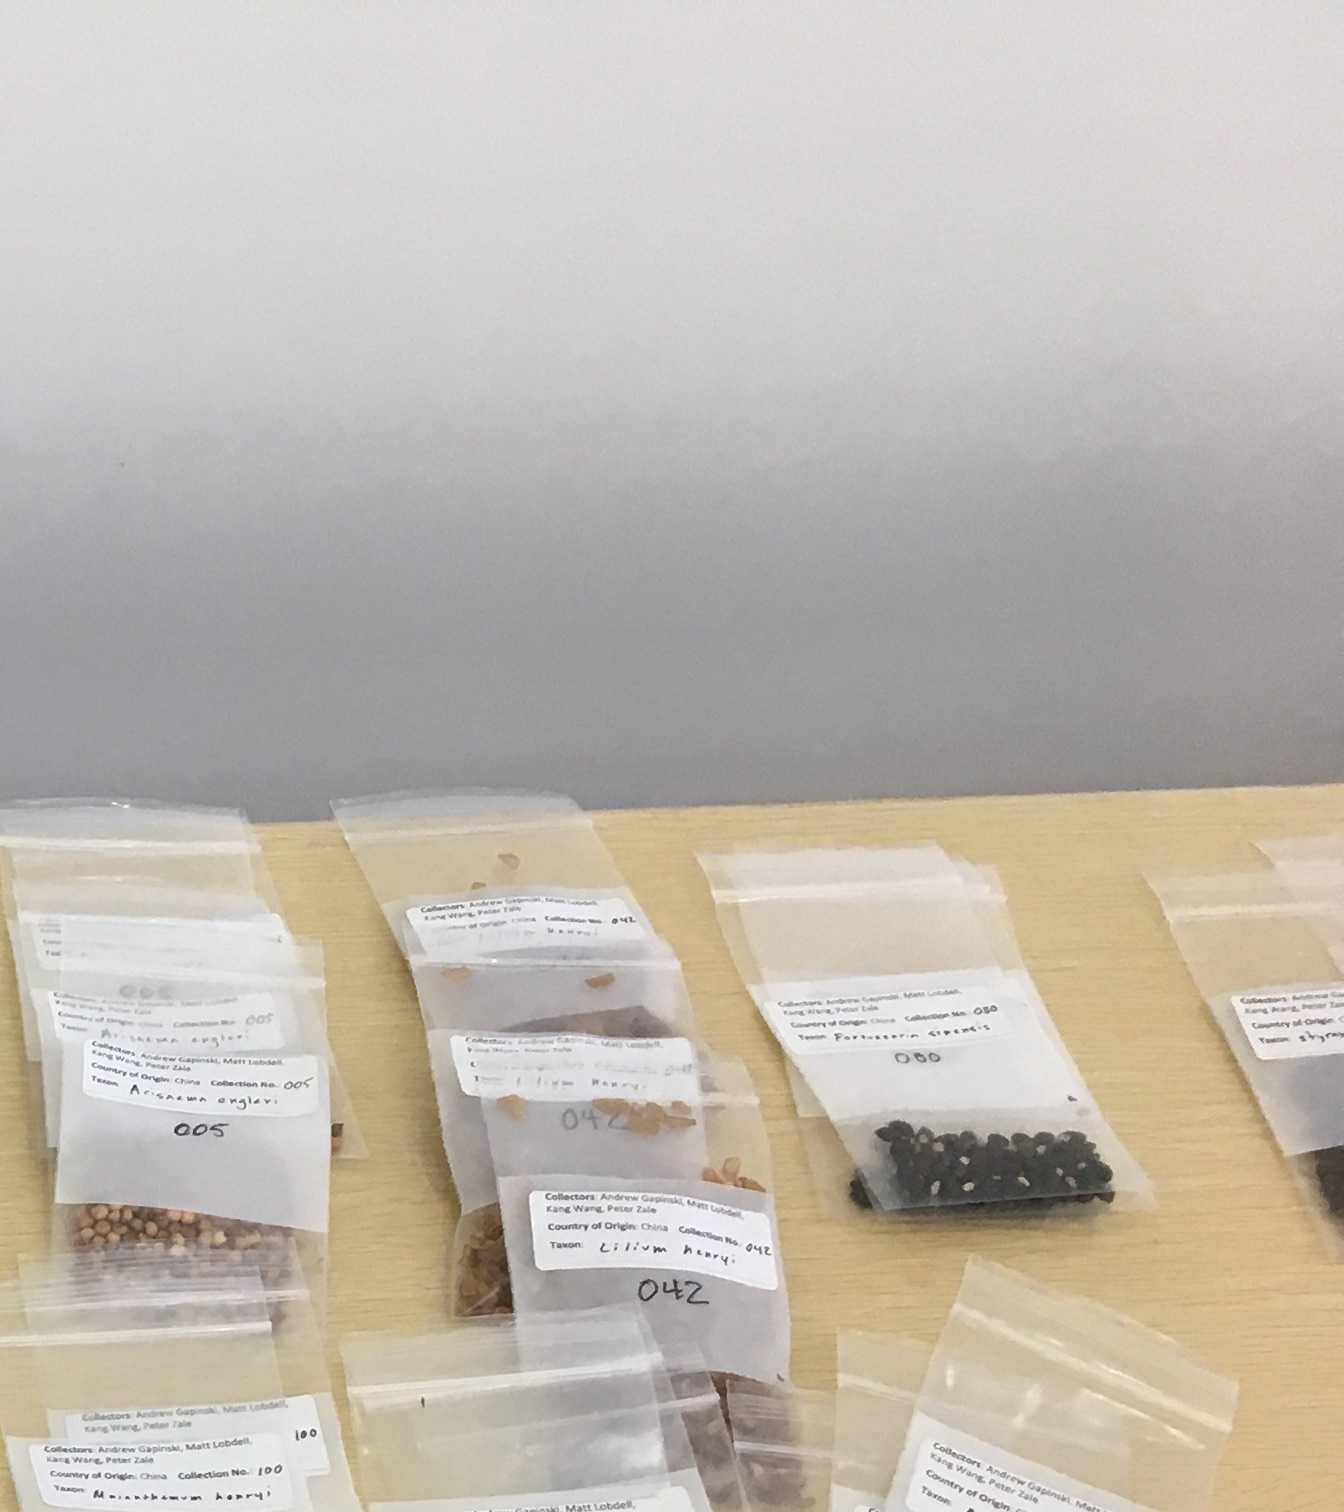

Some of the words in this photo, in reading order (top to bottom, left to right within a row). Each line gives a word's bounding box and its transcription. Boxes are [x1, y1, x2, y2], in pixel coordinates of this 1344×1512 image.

[174, 1122, 229, 1138] 005
[549, 1241, 584, 1249] Taxon:
[745, 1243, 772, 1256] 042
[638, 1278, 709, 1305] 042
[294, 1428, 318, 1441] 100
